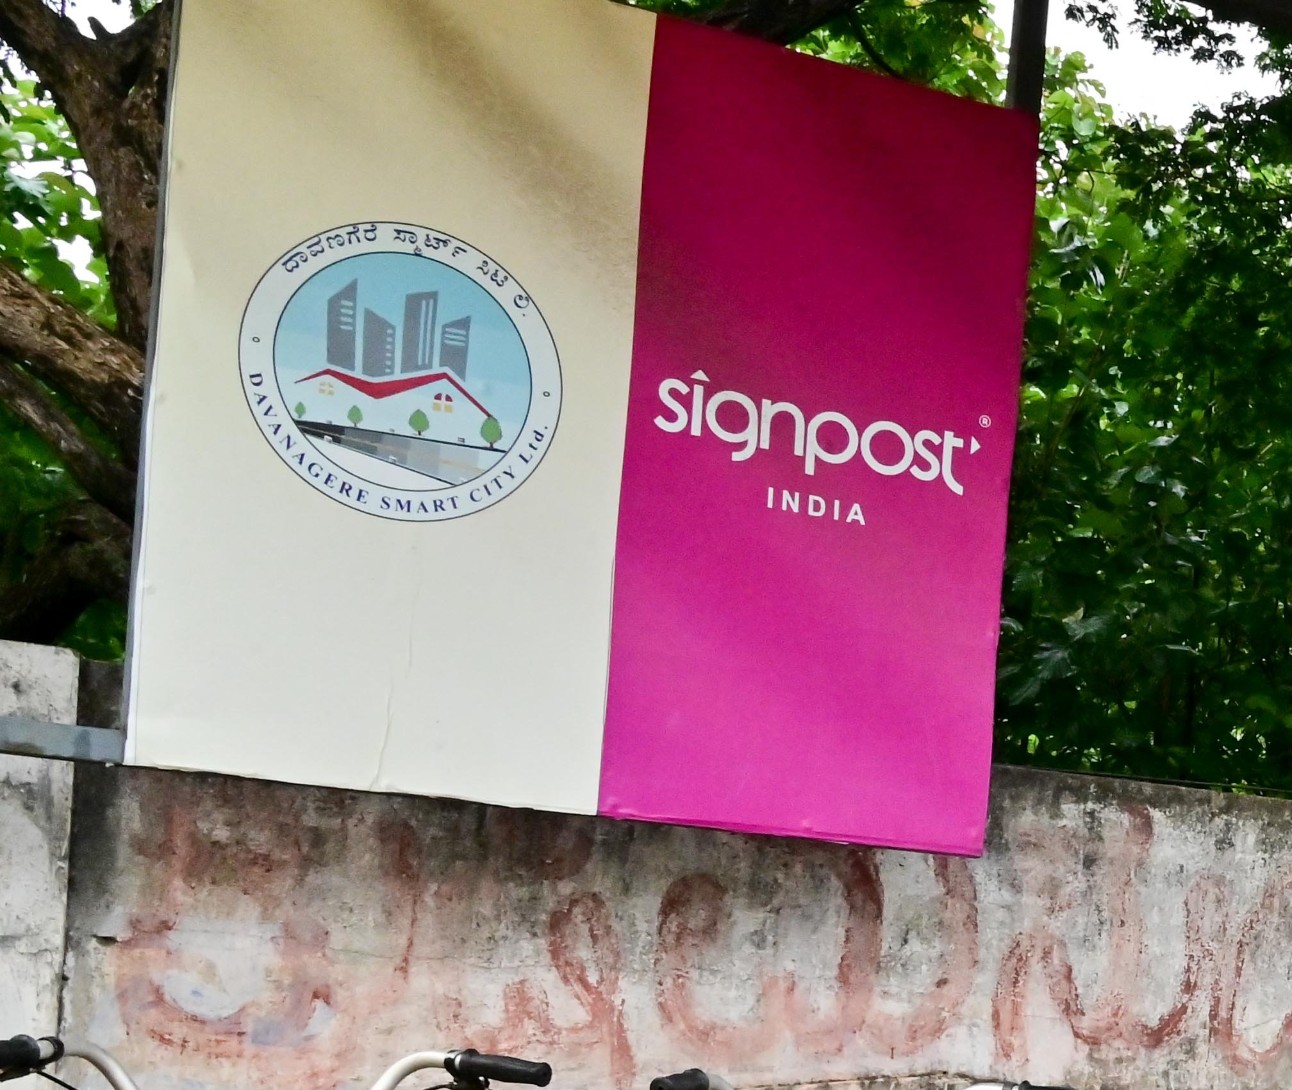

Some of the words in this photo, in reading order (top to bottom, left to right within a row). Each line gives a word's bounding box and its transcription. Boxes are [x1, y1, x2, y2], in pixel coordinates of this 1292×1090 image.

[249, 373, 370, 505] DAVANAGERE
[380, 494, 461, 514] SMART
[469, 467, 518, 504] CITY
[519, 426, 549, 465] Ltd.
[767, 486, 866, 526] INDIA
